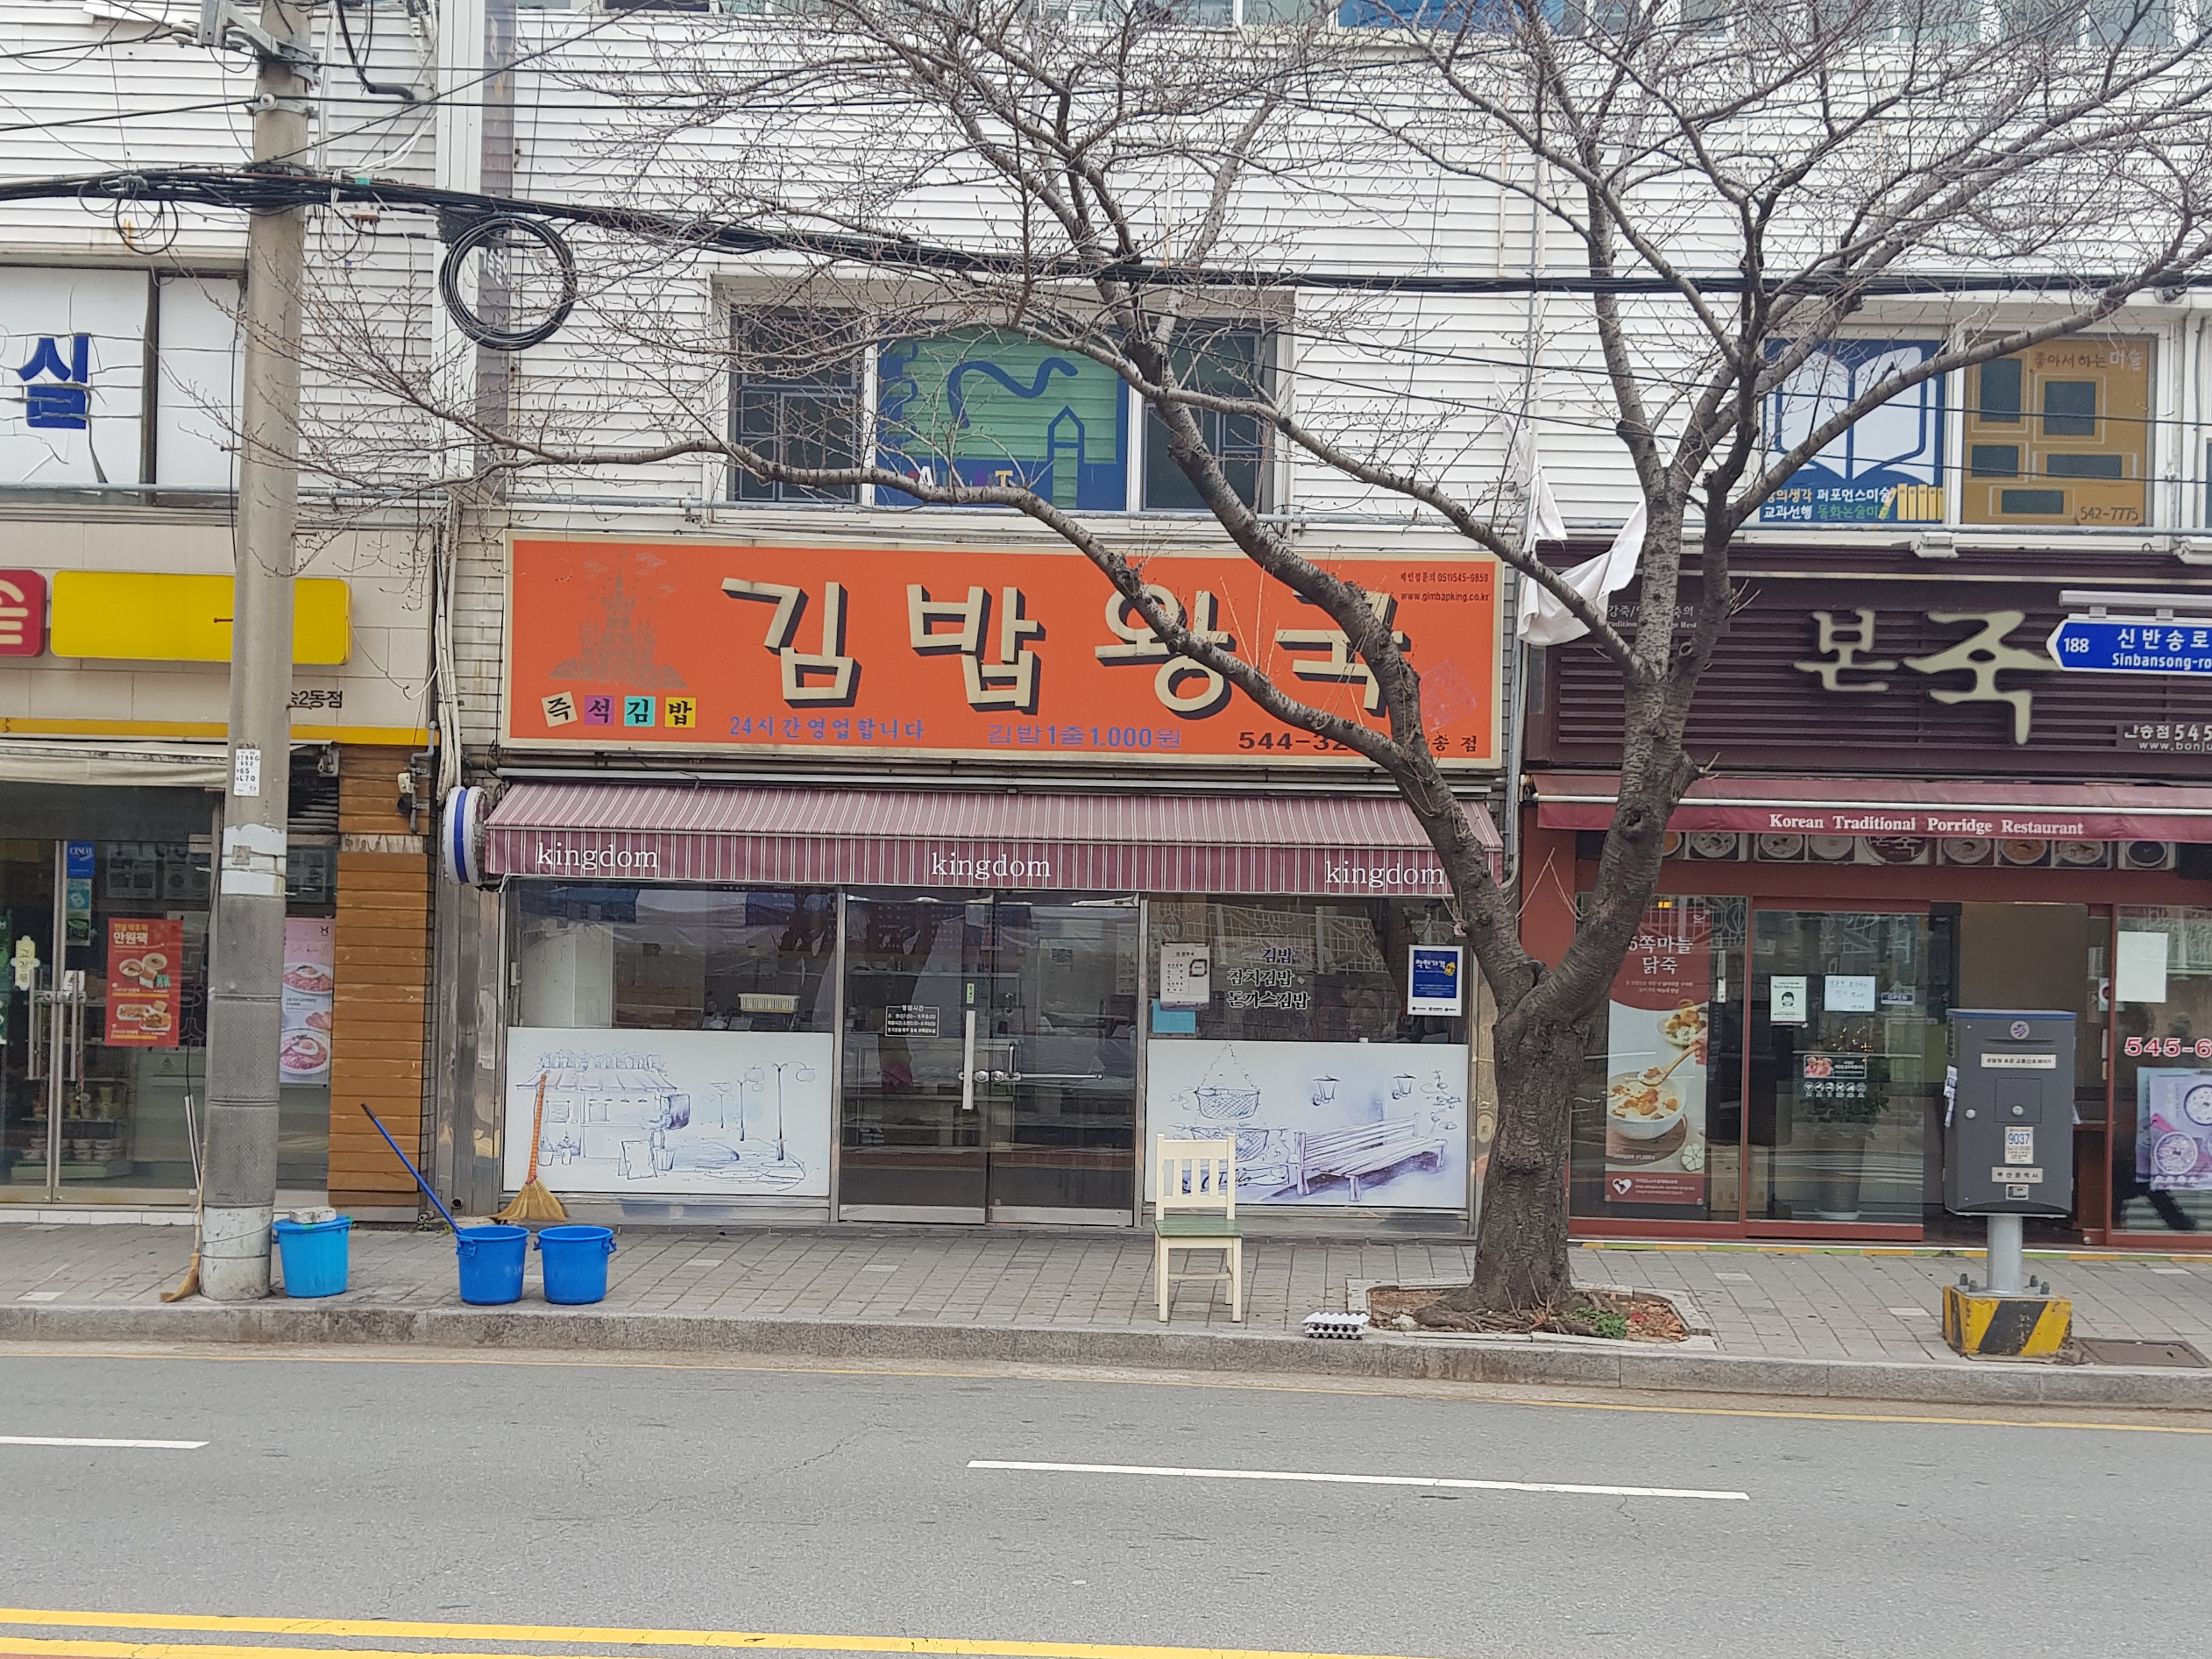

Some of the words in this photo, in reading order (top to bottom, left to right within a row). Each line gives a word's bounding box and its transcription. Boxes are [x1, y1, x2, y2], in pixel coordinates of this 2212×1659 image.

[2078, 354, 2106, 368] 하는
[17, 332, 89, 430] 실
[1817, 487, 1891, 503] 퍼포먼스미술
[1763, 505, 1812, 520] 교과선행
[2080, 506, 2138, 521] 542-7775
[2063, 637, 2090, 653] 188
[2117, 628, 2210, 652] 신반송로
[2112, 652, 2212, 671] Sinbansong-ro
[1793, 608, 2058, 745] 본죽
[547, 698, 693, 726] 즉석김밥
[1769, 814, 1824, 829] Korean
[1832, 815, 1916, 831] Traditional
[1927, 817, 1993, 833] Porridge
[2001, 820, 2084, 836] Restaurant
[537, 842, 659, 870] kingdom
[932, 852, 1051, 880] kingdom
[1325, 860, 1446, 888] kingdom
[1262, 947, 1295, 964] 김밥
[1642, 956, 1678, 975] 닭죽
[1227, 968, 1295, 986] 참치김밥
[1227, 990, 1311, 1009] 돈까스김밥
[2008, 1133, 2030, 1145] 9037
